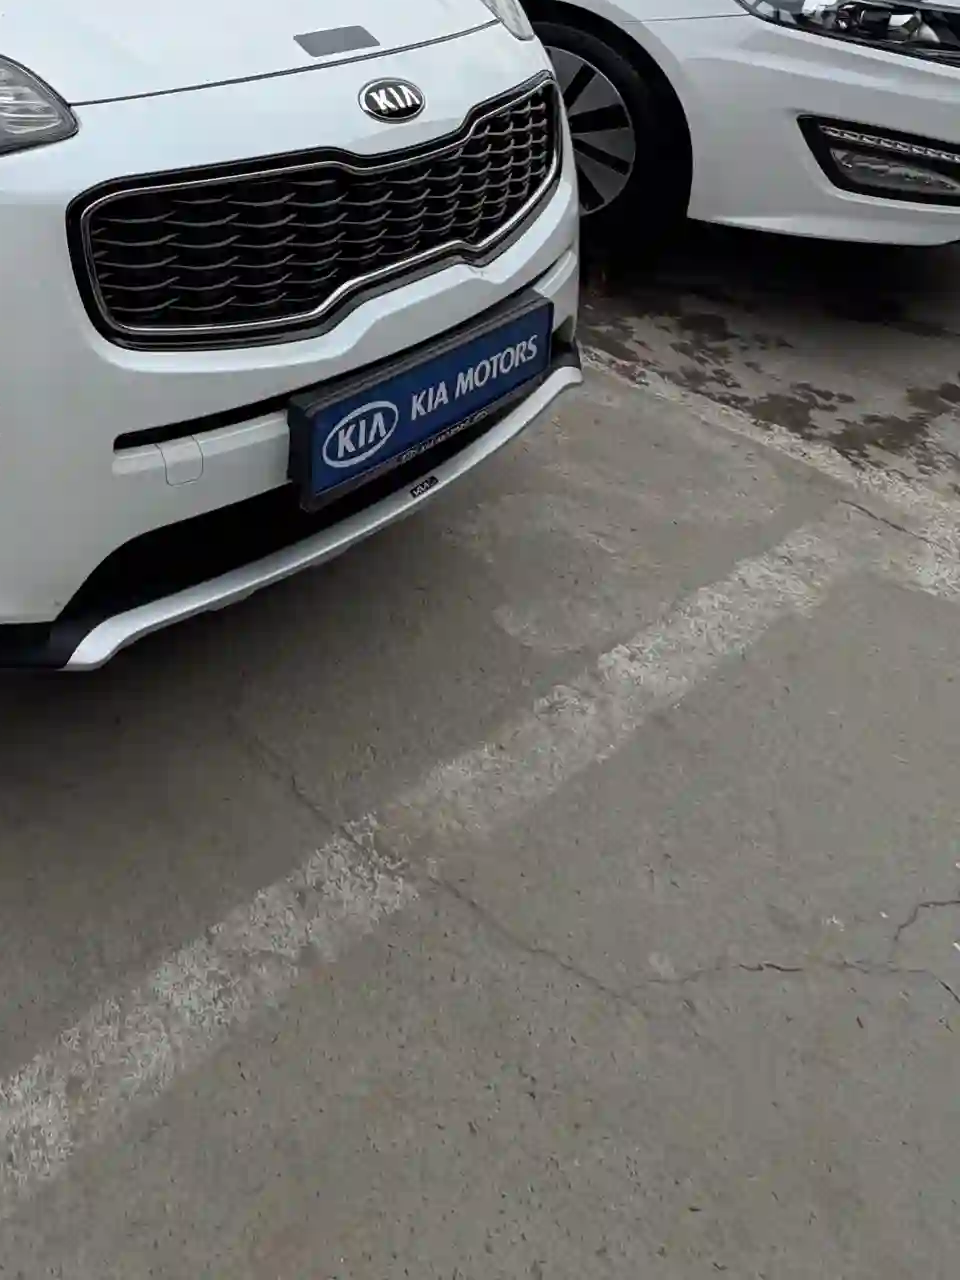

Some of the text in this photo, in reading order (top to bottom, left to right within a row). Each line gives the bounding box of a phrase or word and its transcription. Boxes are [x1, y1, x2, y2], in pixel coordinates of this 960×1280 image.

[411, 334, 539, 421] KIA MOTORS
[337, 411, 387, 459] KIA
